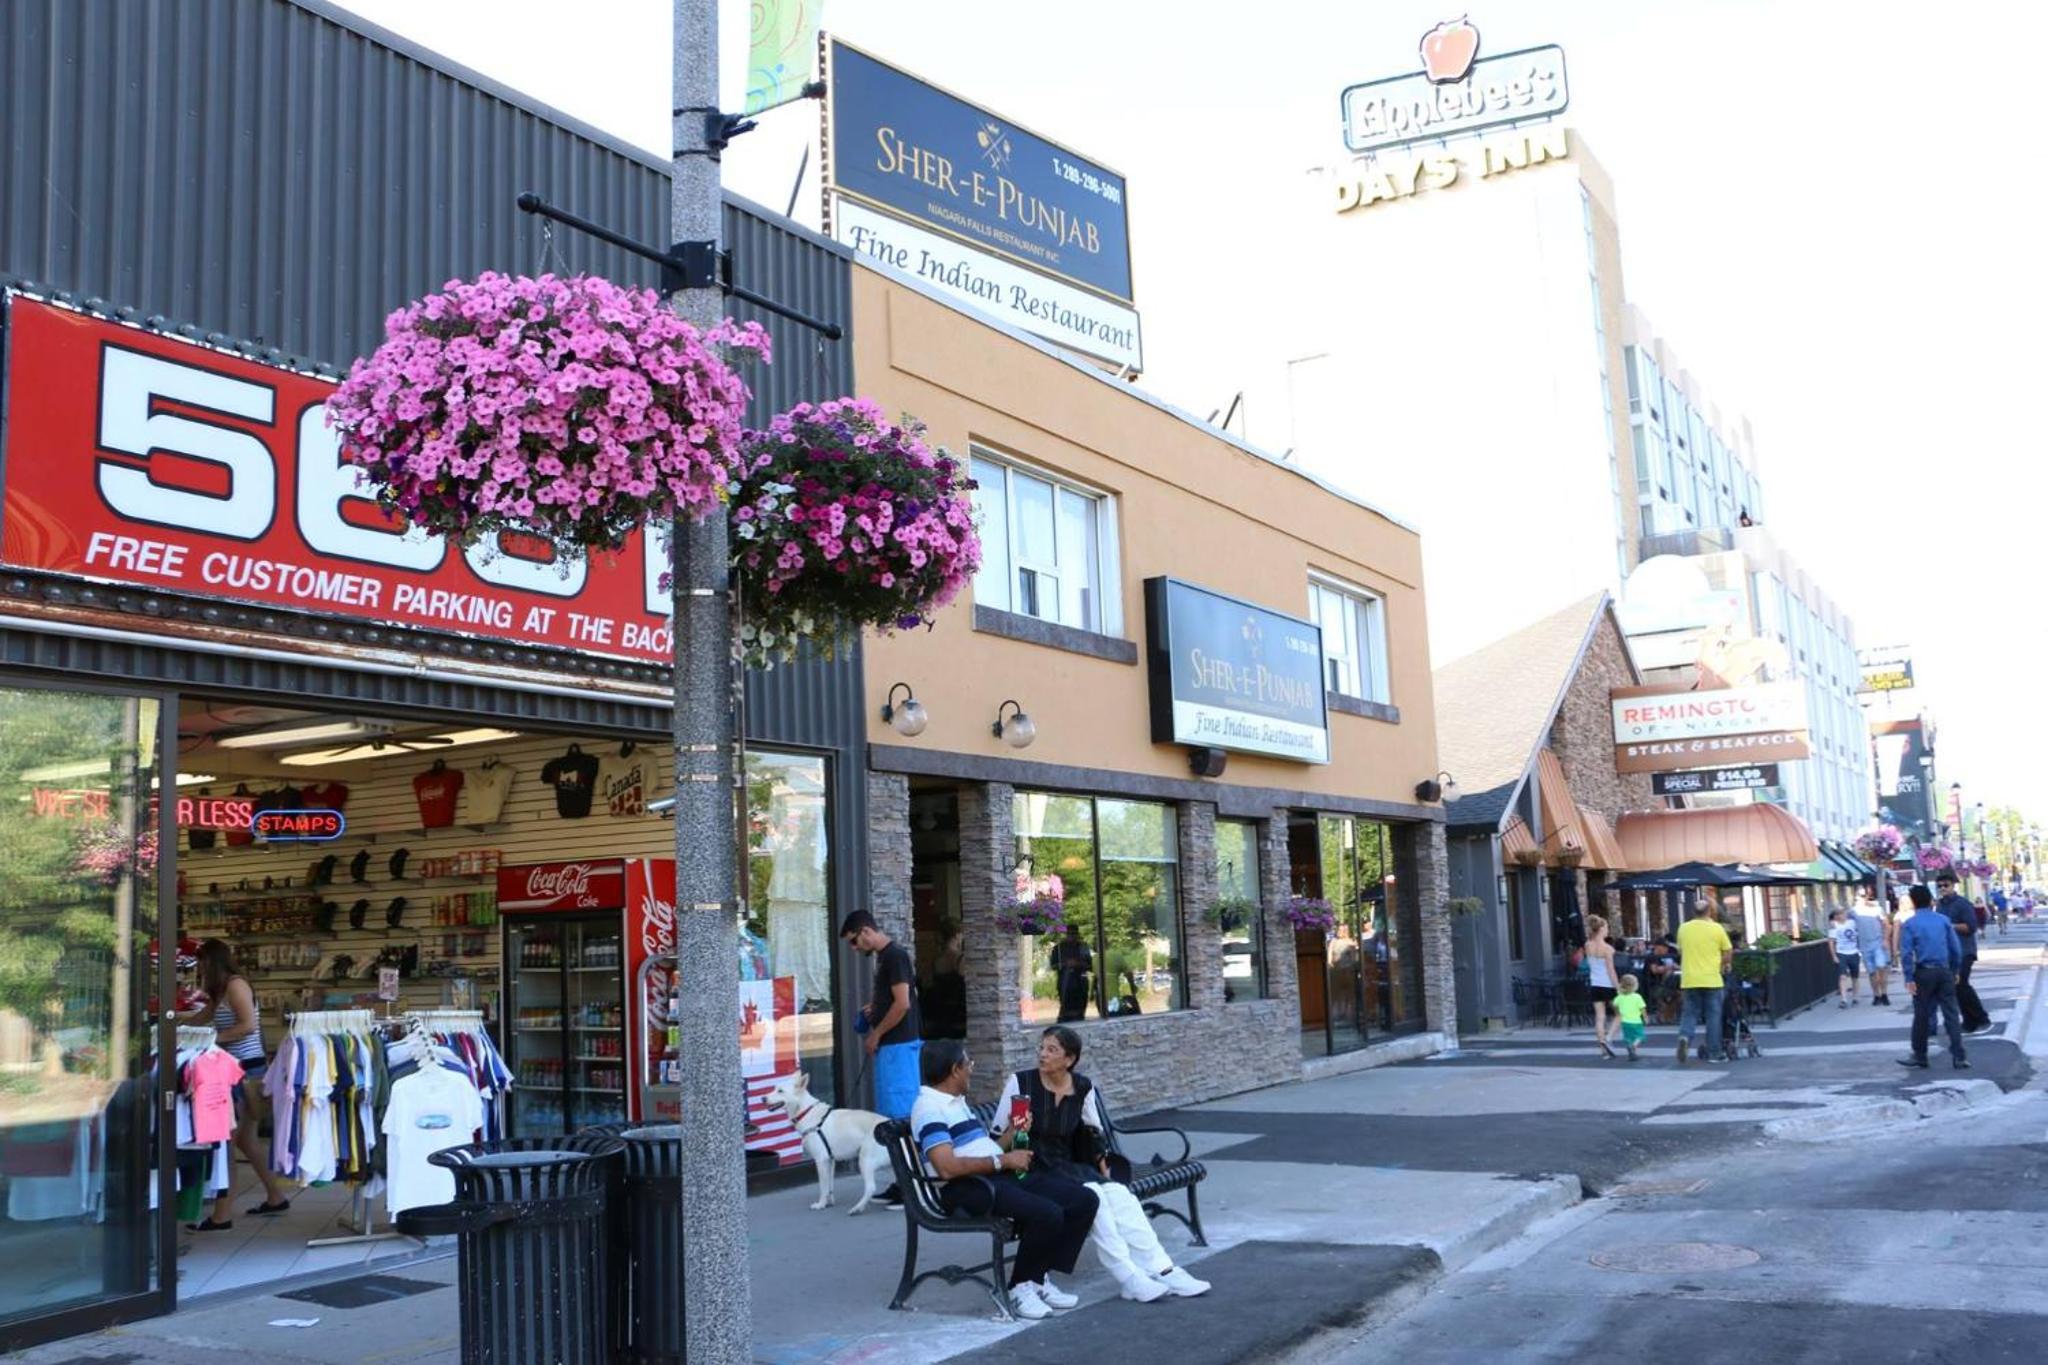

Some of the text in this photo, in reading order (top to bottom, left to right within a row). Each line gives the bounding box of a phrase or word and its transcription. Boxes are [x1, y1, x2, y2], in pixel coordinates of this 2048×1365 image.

[1335, 127, 1570, 215] DAYS INN
[876, 127, 1101, 254] SHER-E-PUNJAB
[928, 202, 966, 228] NIAGARA
[967, 218, 992, 237] FALLS
[849, 224, 1134, 351] Fine Indian Restaurant
[85, 530, 189, 579] FREE
[202, 550, 382, 609] CUSTOMER
[393, 582, 513, 630] PARKING
[522, 606, 556, 634] AT
[567, 612, 613, 644] THE
[1192, 710, 1221, 735] Fine
[1627, 733, 1797, 757] STEAK & SEAFOOD
[605, 763, 643, 800] Canada
[200, 800, 252, 828] LESS
[259, 816, 338, 832] STAMPS
[577, 894, 600, 908] Coke
